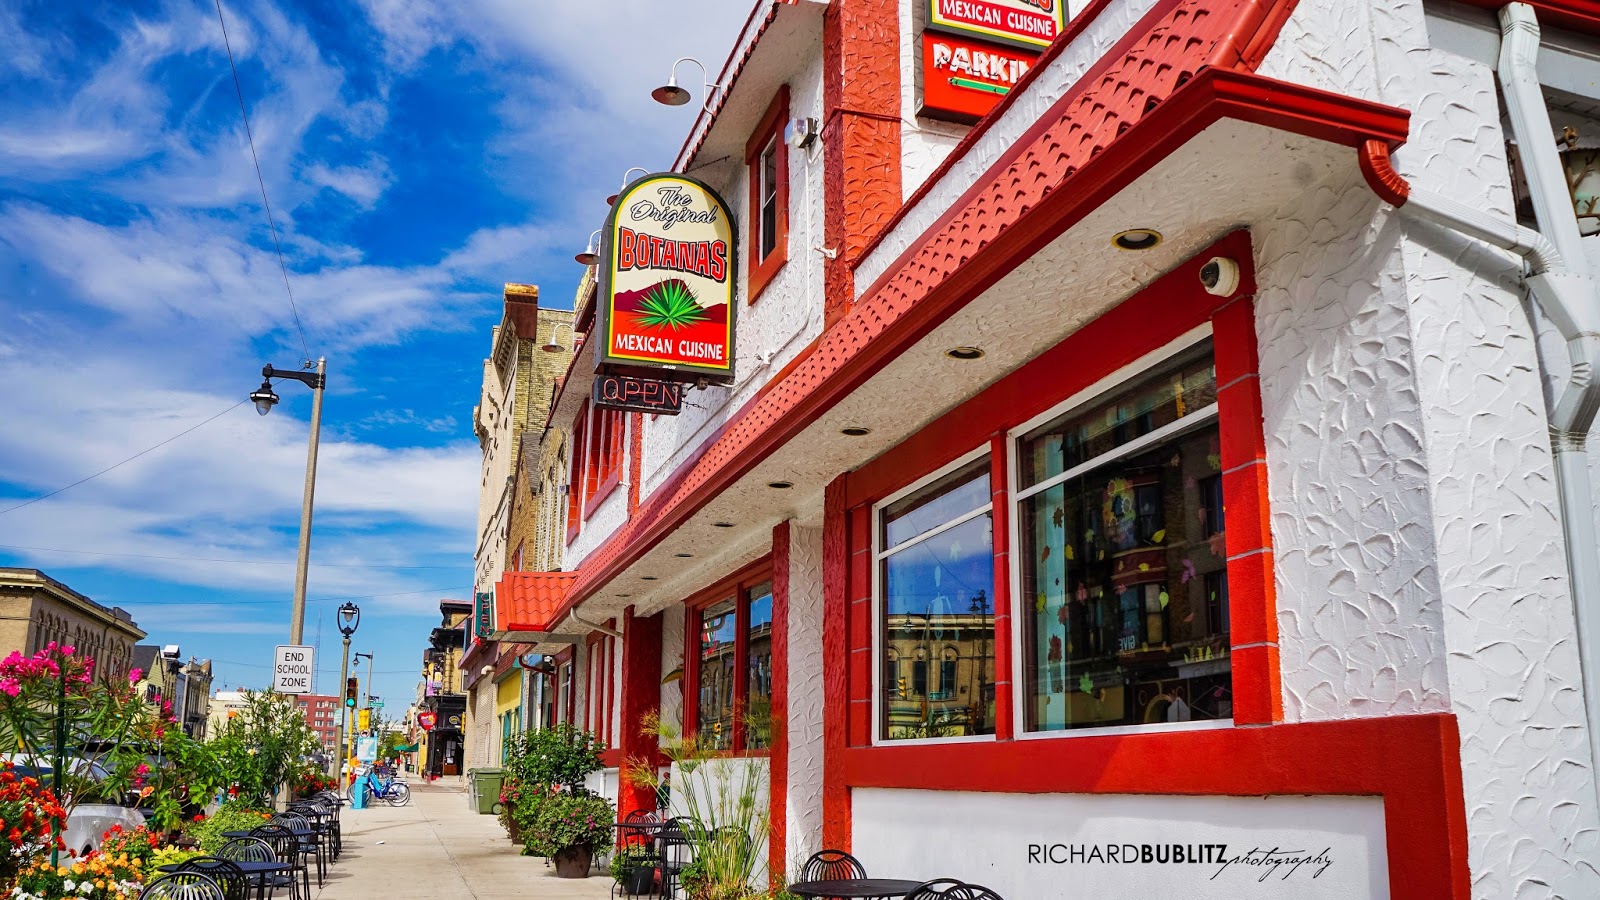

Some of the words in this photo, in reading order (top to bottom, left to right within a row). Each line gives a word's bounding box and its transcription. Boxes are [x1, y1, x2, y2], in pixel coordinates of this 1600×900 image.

[942, 0, 1001, 26] MEXICAN
[1007, 12, 1053, 37] CUISINE
[657, 185, 692, 207] The
[630, 200, 718, 231] Original
[618, 226, 727, 283] BOTANAS
[615, 333, 673, 355] MEXICAN
[678, 340, 723, 360] CUISINE
[603, 378, 679, 407] OPEN
[480, 592, 490, 635] OPEN
[277, 664, 310, 675] SCHOOL
[284, 652, 304, 662] END
[280, 677, 307, 687] ZONE
